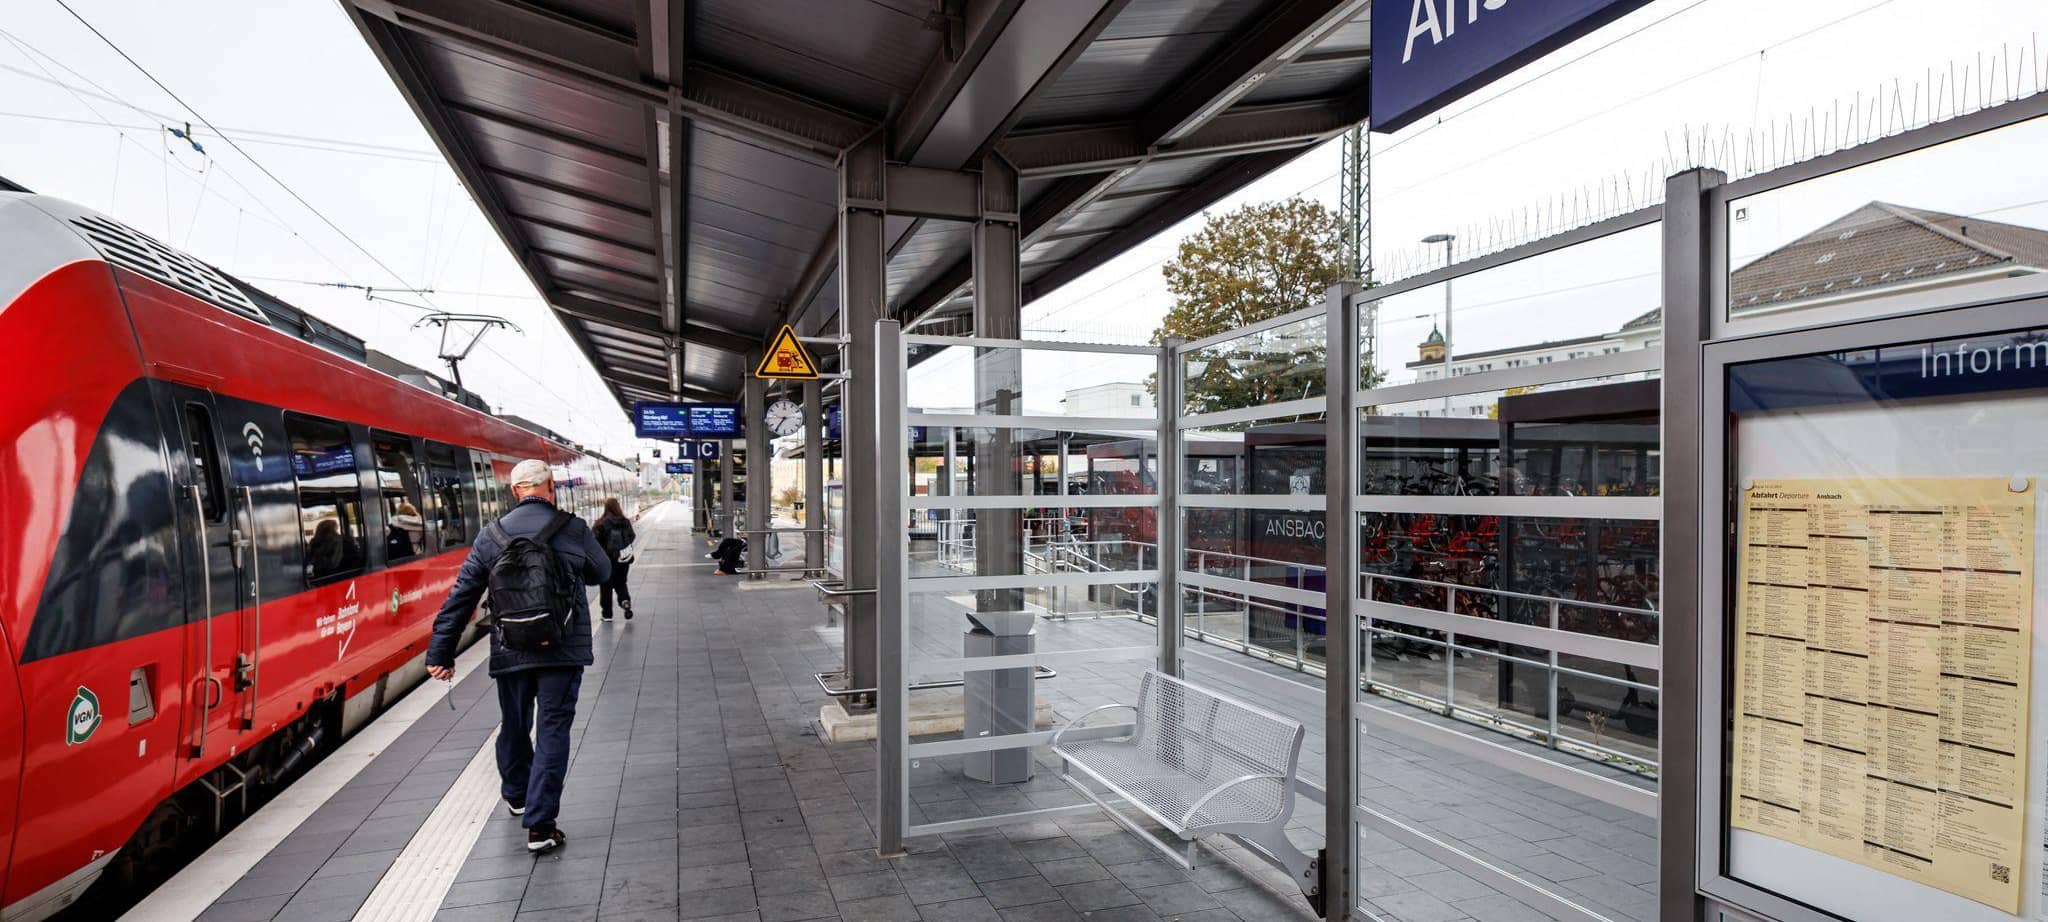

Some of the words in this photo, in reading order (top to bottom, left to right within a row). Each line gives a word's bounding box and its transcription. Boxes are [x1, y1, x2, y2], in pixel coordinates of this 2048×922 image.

[680, 443, 688, 456] 1
[701, 443, 713, 457] C
[1751, 492, 1778, 500] Abfahrt
[1779, 492, 1809, 500] Departure
[250, 581, 256, 597] 2
[74, 709, 93, 725] VGN
